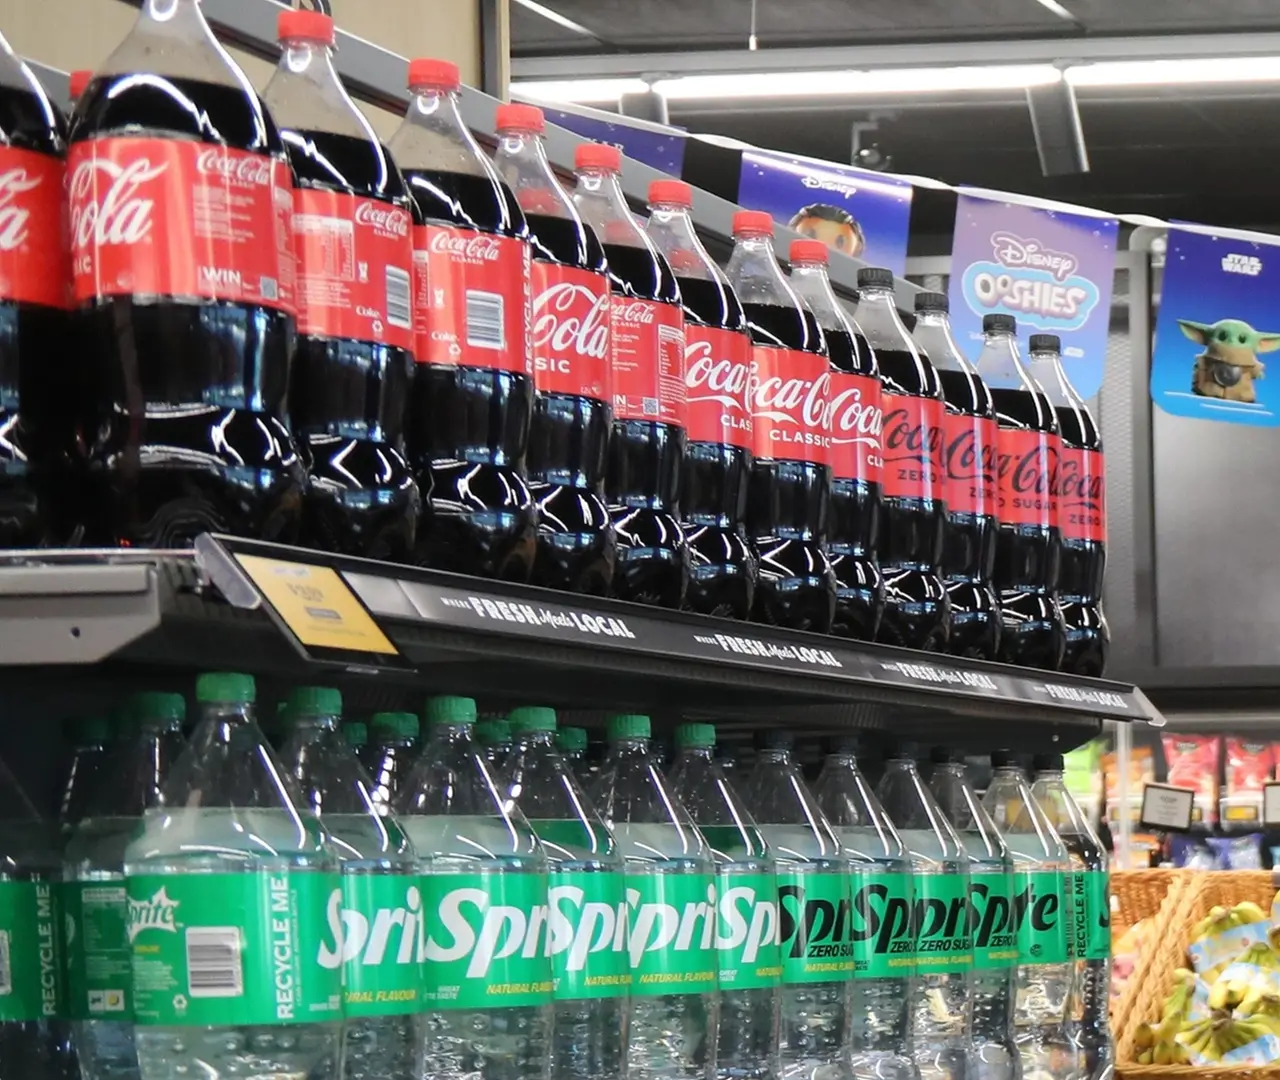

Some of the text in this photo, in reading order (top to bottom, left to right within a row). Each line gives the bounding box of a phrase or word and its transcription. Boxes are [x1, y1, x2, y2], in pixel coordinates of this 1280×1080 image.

[802, 174, 857, 199] Disney
[995, 235, 1073, 278] Disney
[203, 266, 242, 283] WIN
[521, 246, 536, 374] RECYCLE ME
[470, 596, 540, 627] FRESH
[571, 612, 636, 640] LOCAL
[716, 634, 769, 660] FRESH
[794, 645, 842, 668] LOCAL
[897, 661, 999, 691] FRESH LOCAL
[1045, 683, 1082, 703] FRESH
[1095, 691, 1129, 709] LOCAL
[1074, 874, 1088, 958] RECYCLE ME
[36, 883, 58, 1017] RECYCLE ME
[269, 875, 296, 1020] RECYCLE ME
[808, 944, 838, 958] ZERO
[918, 941, 951, 953] ZERO
[487, 982, 531, 995] NATURAL
[639, 973, 683, 984] NATURAL
